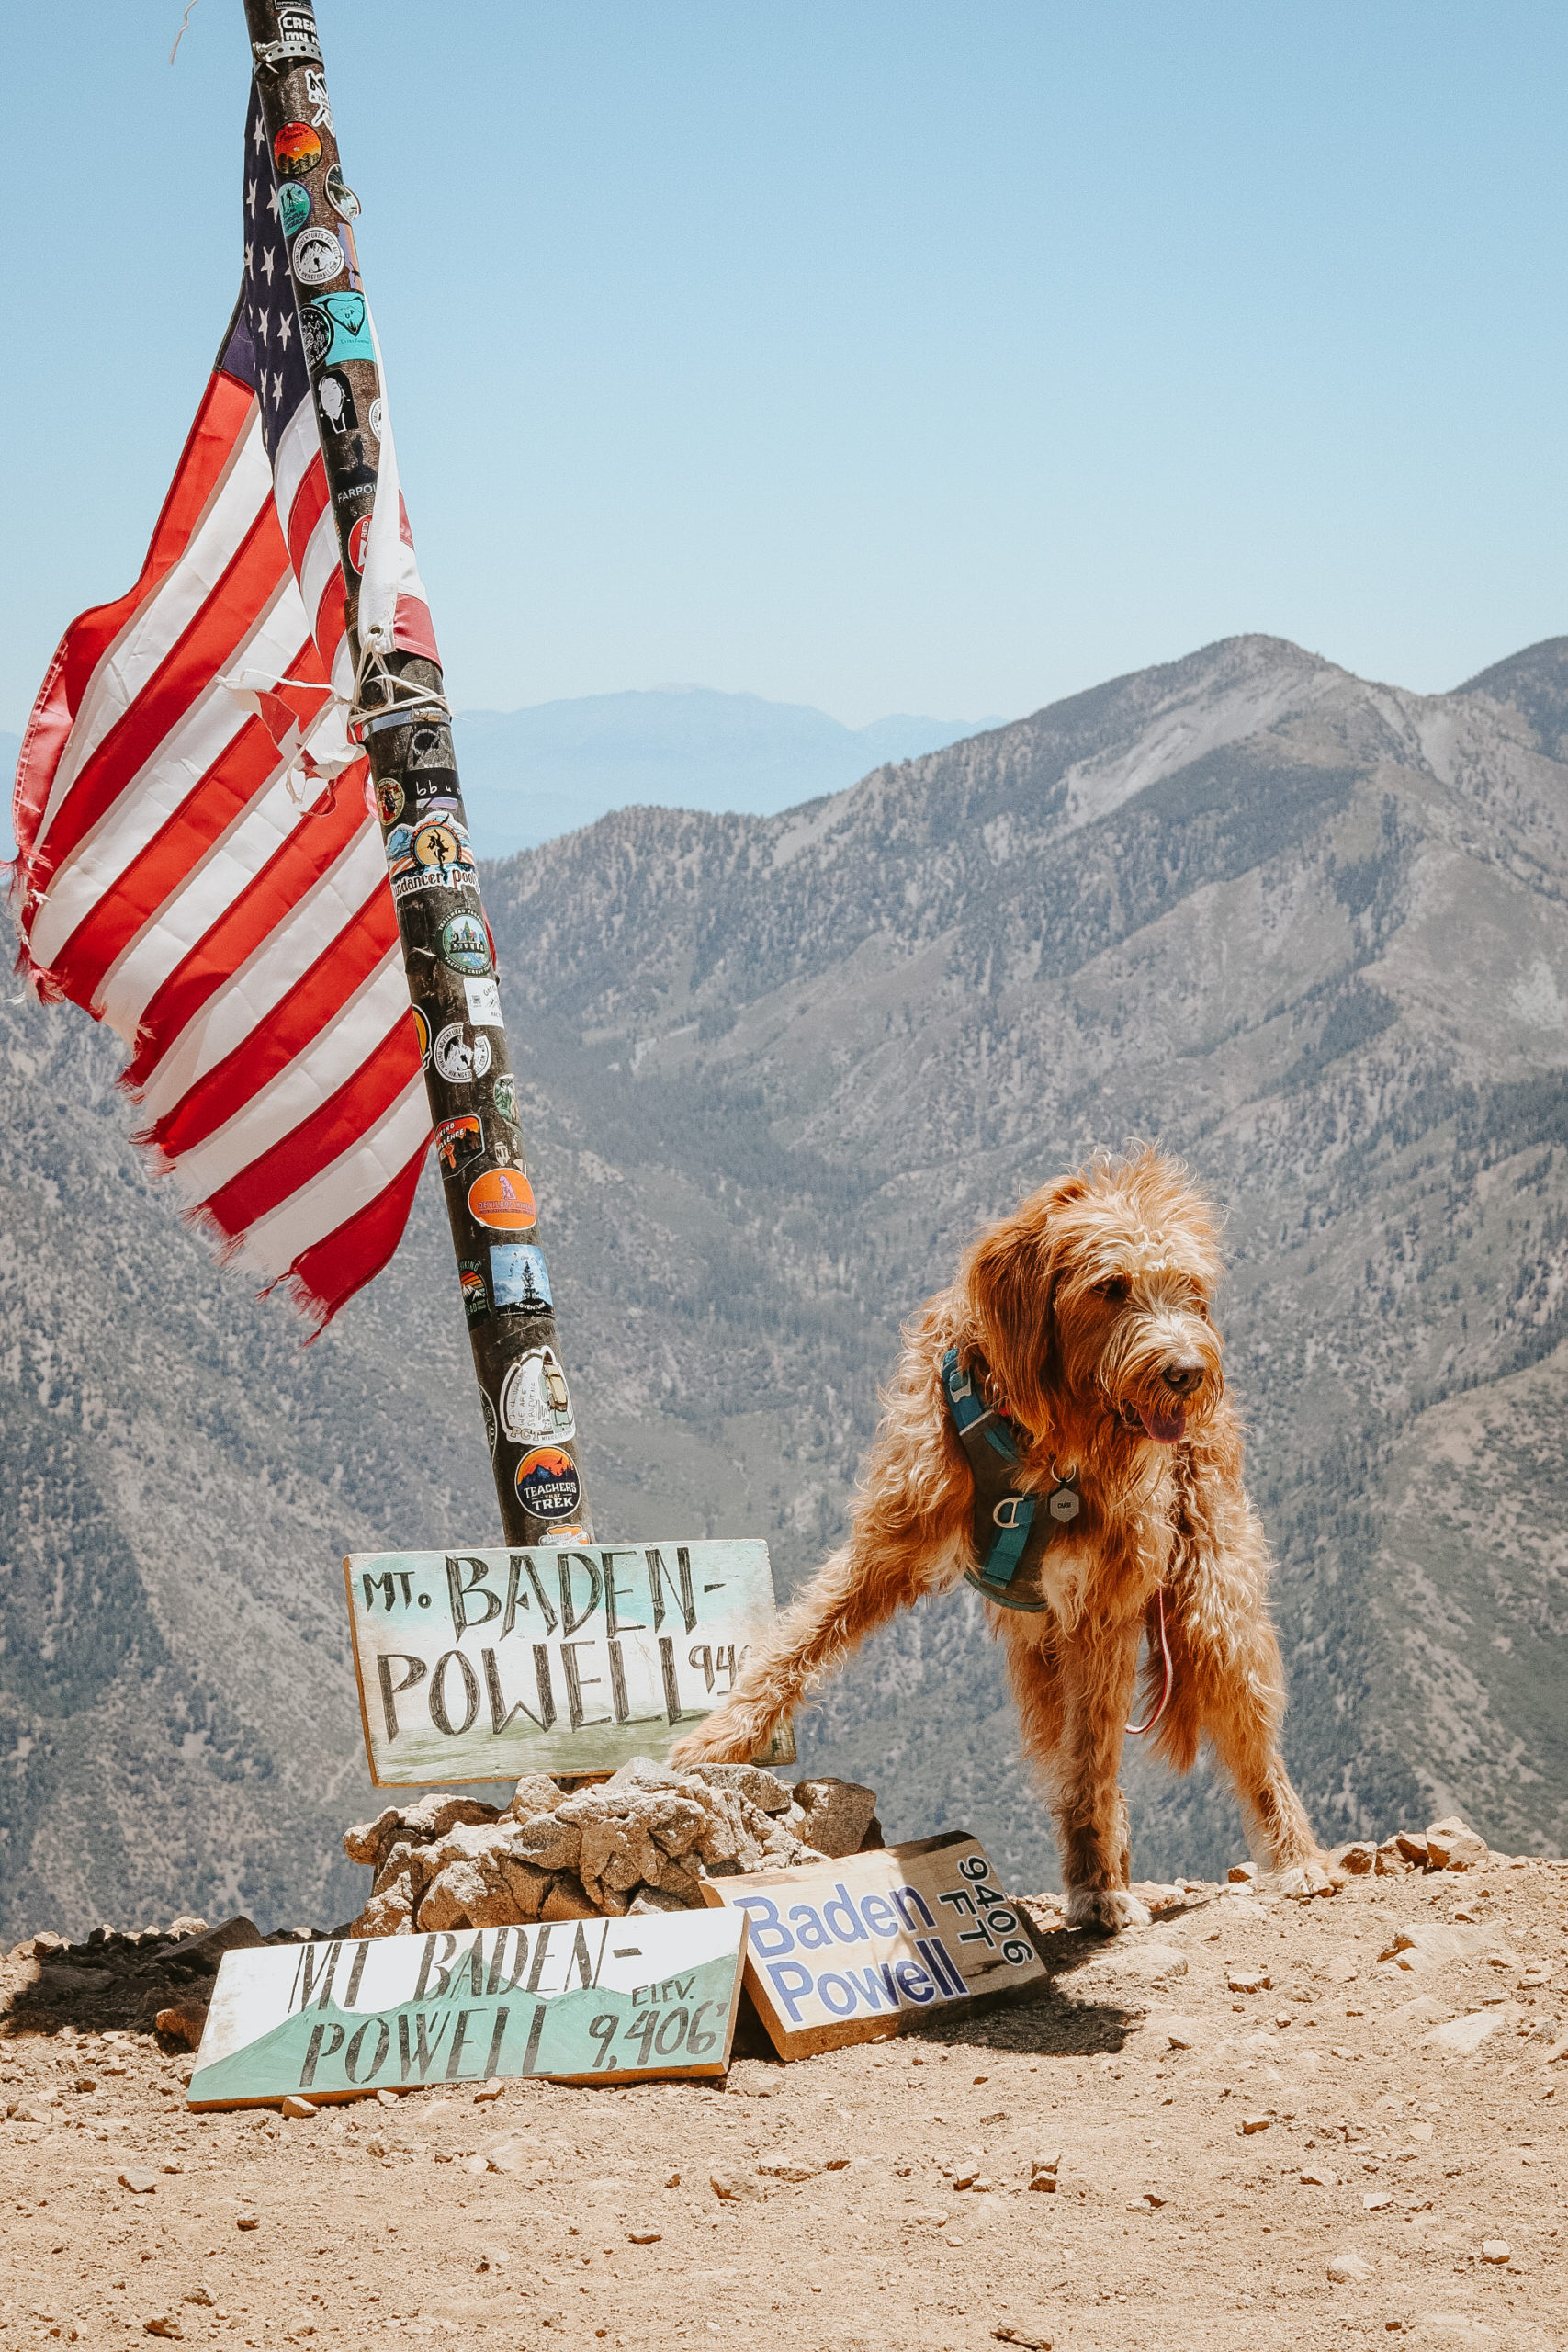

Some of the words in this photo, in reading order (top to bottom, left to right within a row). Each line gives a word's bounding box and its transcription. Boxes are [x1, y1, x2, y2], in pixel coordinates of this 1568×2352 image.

[297, 232, 324, 251] ADVENTURES
[360, 520, 369, 537] RED
[438, 909, 466, 930] TRAILHEAD
[445, 956, 467, 973] PACIFIC
[438, 1028, 463, 1048] ADVENTURE
[514, 1301, 547, 1311] ADVENTURE
[510, 1426, 542, 1442] PCT
[523, 1482, 577, 1498] TEACHERS
[531, 1497, 575, 1511] TREK
[362, 1571, 432, 1612] MT.
[445, 1547, 727, 1643] BADEN-
[377, 1635, 713, 1744] POWELL
[732, 1881, 938, 1959] Baden
[937, 1888, 997, 1951] FT
[957, 1853, 1035, 1968] 9406
[288, 1937, 383, 2014] MT
[413, 1918, 644, 2002] BADEN-
[632, 1977, 695, 2008] ELEV.
[765, 1937, 971, 2023] Powell
[299, 2003, 555, 2088] POWELL
